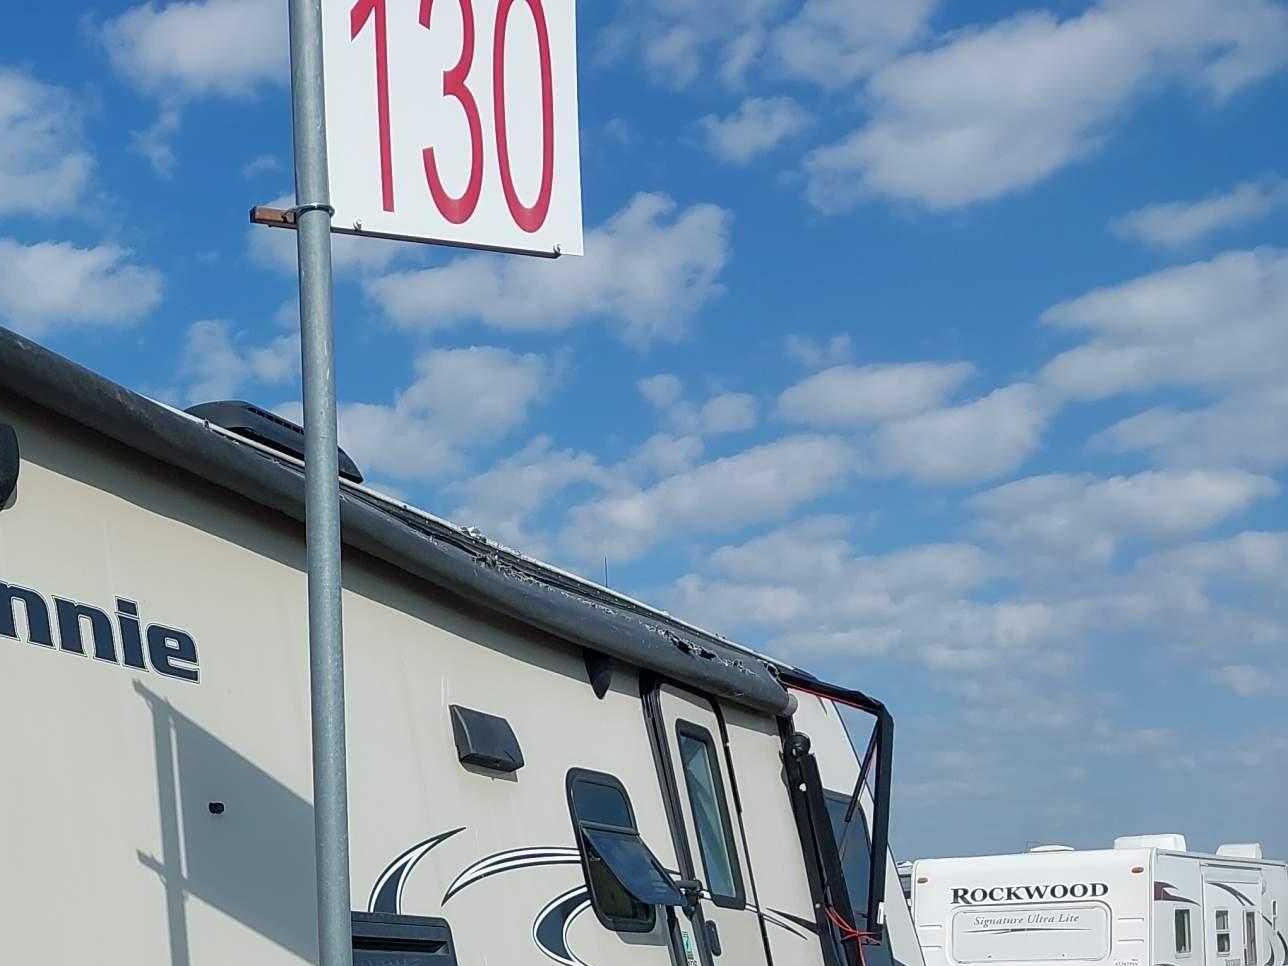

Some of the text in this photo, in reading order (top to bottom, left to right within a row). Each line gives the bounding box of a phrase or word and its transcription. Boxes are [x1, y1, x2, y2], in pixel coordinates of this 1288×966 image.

[350, 0, 554, 233] 130
[950, 883, 1109, 905] ROCKWOOD
[973, 913, 1080, 928] Signature Ultra Lite
